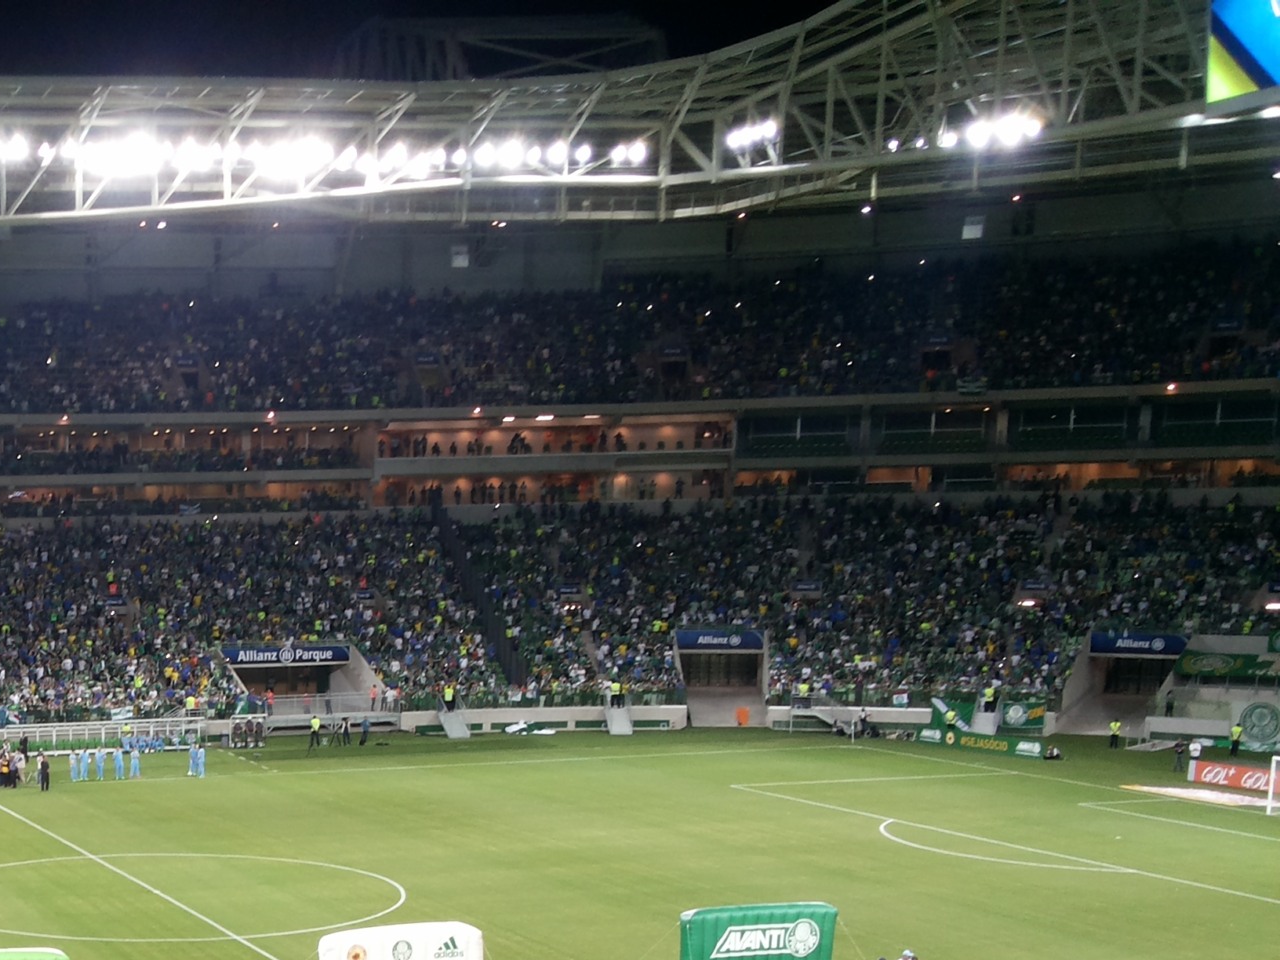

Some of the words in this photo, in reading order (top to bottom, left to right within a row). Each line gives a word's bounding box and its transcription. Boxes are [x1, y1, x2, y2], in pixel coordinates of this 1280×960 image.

[697, 634, 729, 645] Allianz
[1115, 638, 1151, 649] Allianz
[237, 649, 278, 662] Allianz
[295, 648, 333, 663] Parque
[720, 928, 785, 952] AVANTI
[434, 950, 464, 960] adidas
